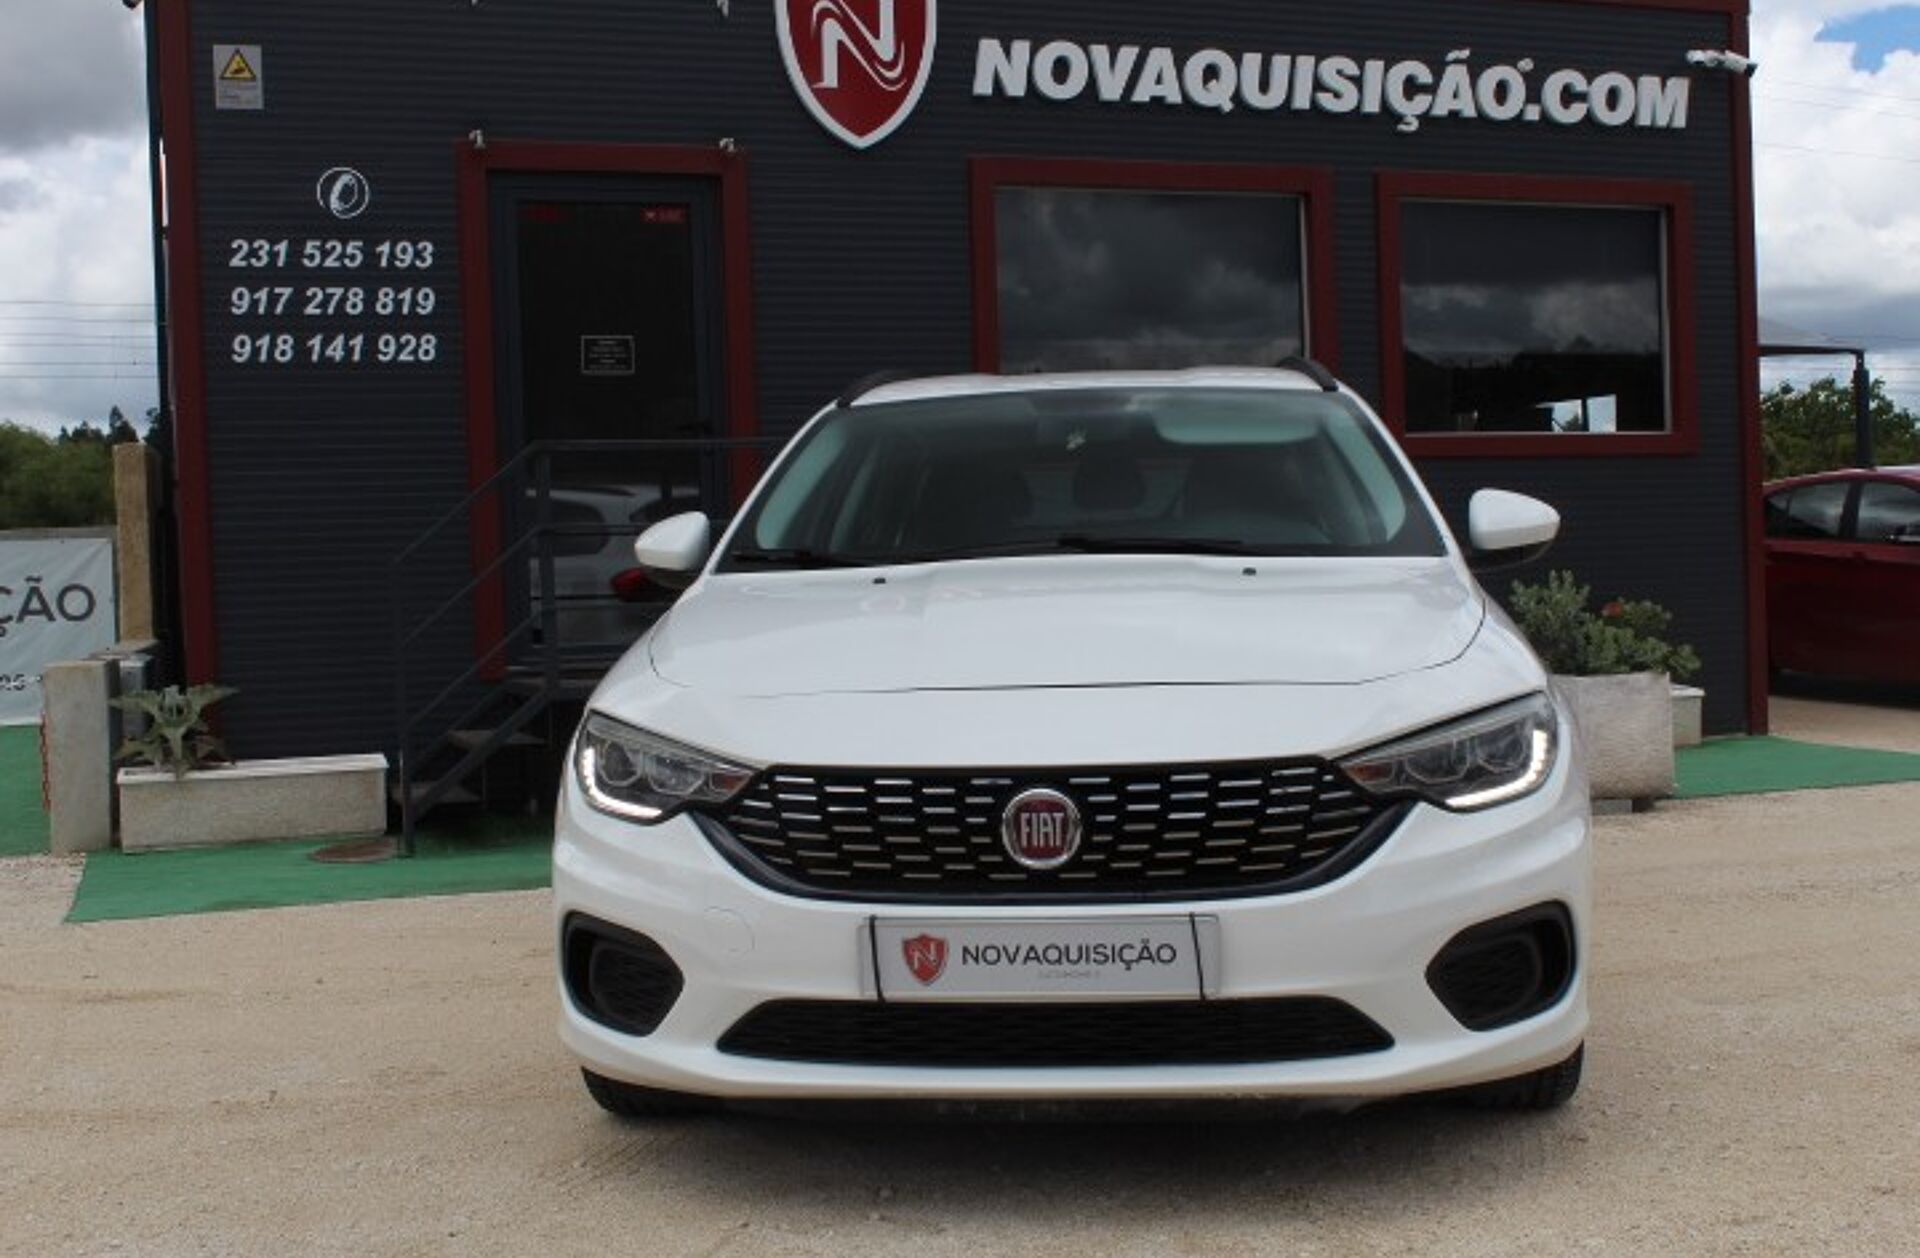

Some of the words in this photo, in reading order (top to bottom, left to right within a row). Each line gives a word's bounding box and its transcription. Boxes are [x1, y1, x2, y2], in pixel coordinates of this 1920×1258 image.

[972, 38, 1690, 132] NOVAQUISIÇÃO.COM
[229, 239, 289, 268] 231
[302, 240, 364, 269] 525
[375, 240, 434, 269] 193
[231, 286, 294, 315] 917
[303, 286, 364, 315] 278
[375, 287, 436, 315] 819
[232, 333, 295, 363] 918
[306, 333, 364, 362] 141
[377, 334, 437, 362] 928
[1020, 812, 1064, 848] FIAT
[961, 938, 1177, 971] NOVAQUISIÇÃO
